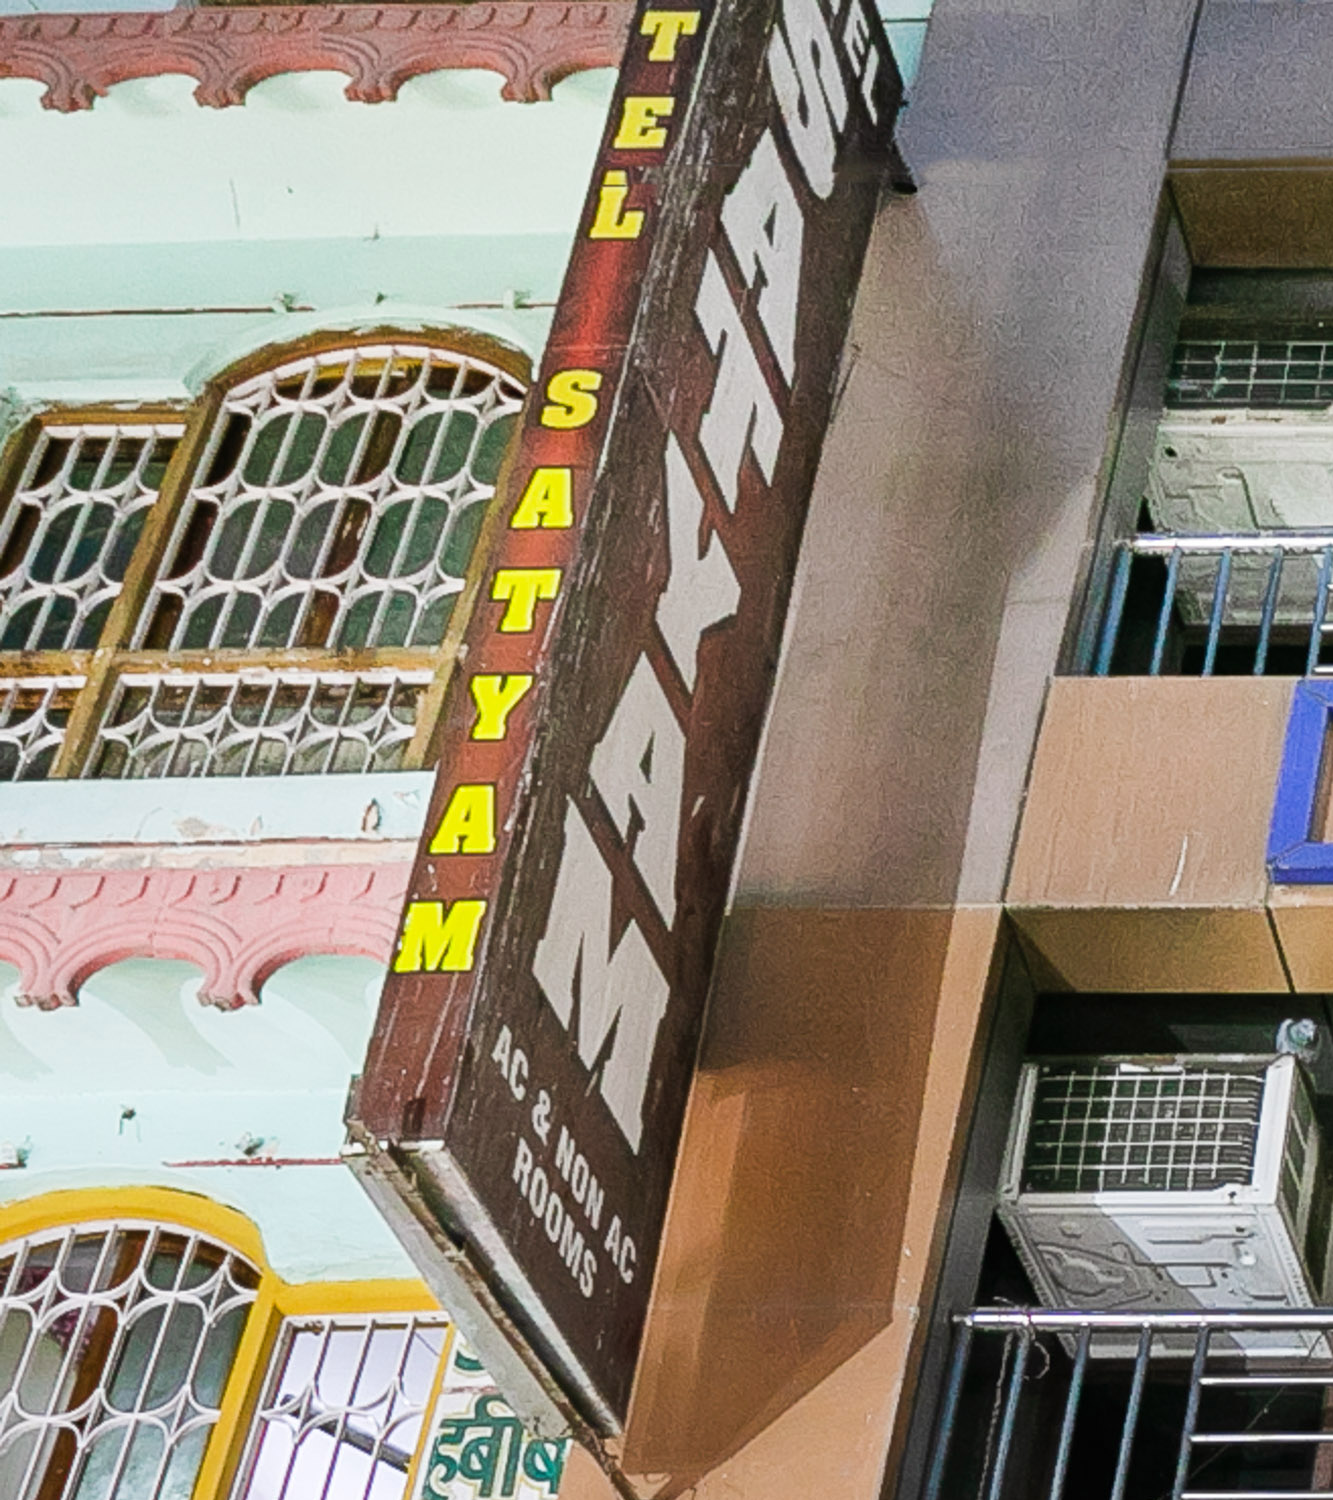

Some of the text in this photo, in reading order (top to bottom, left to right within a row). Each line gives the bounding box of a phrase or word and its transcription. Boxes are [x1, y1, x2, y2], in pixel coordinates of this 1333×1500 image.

[395, 368, 602, 975] SATYAM
[533, 0, 849, 1156] SATYAM
[491, 1024, 637, 1285] AC & NON AC
[512, 1136, 598, 1299] ROOMS
